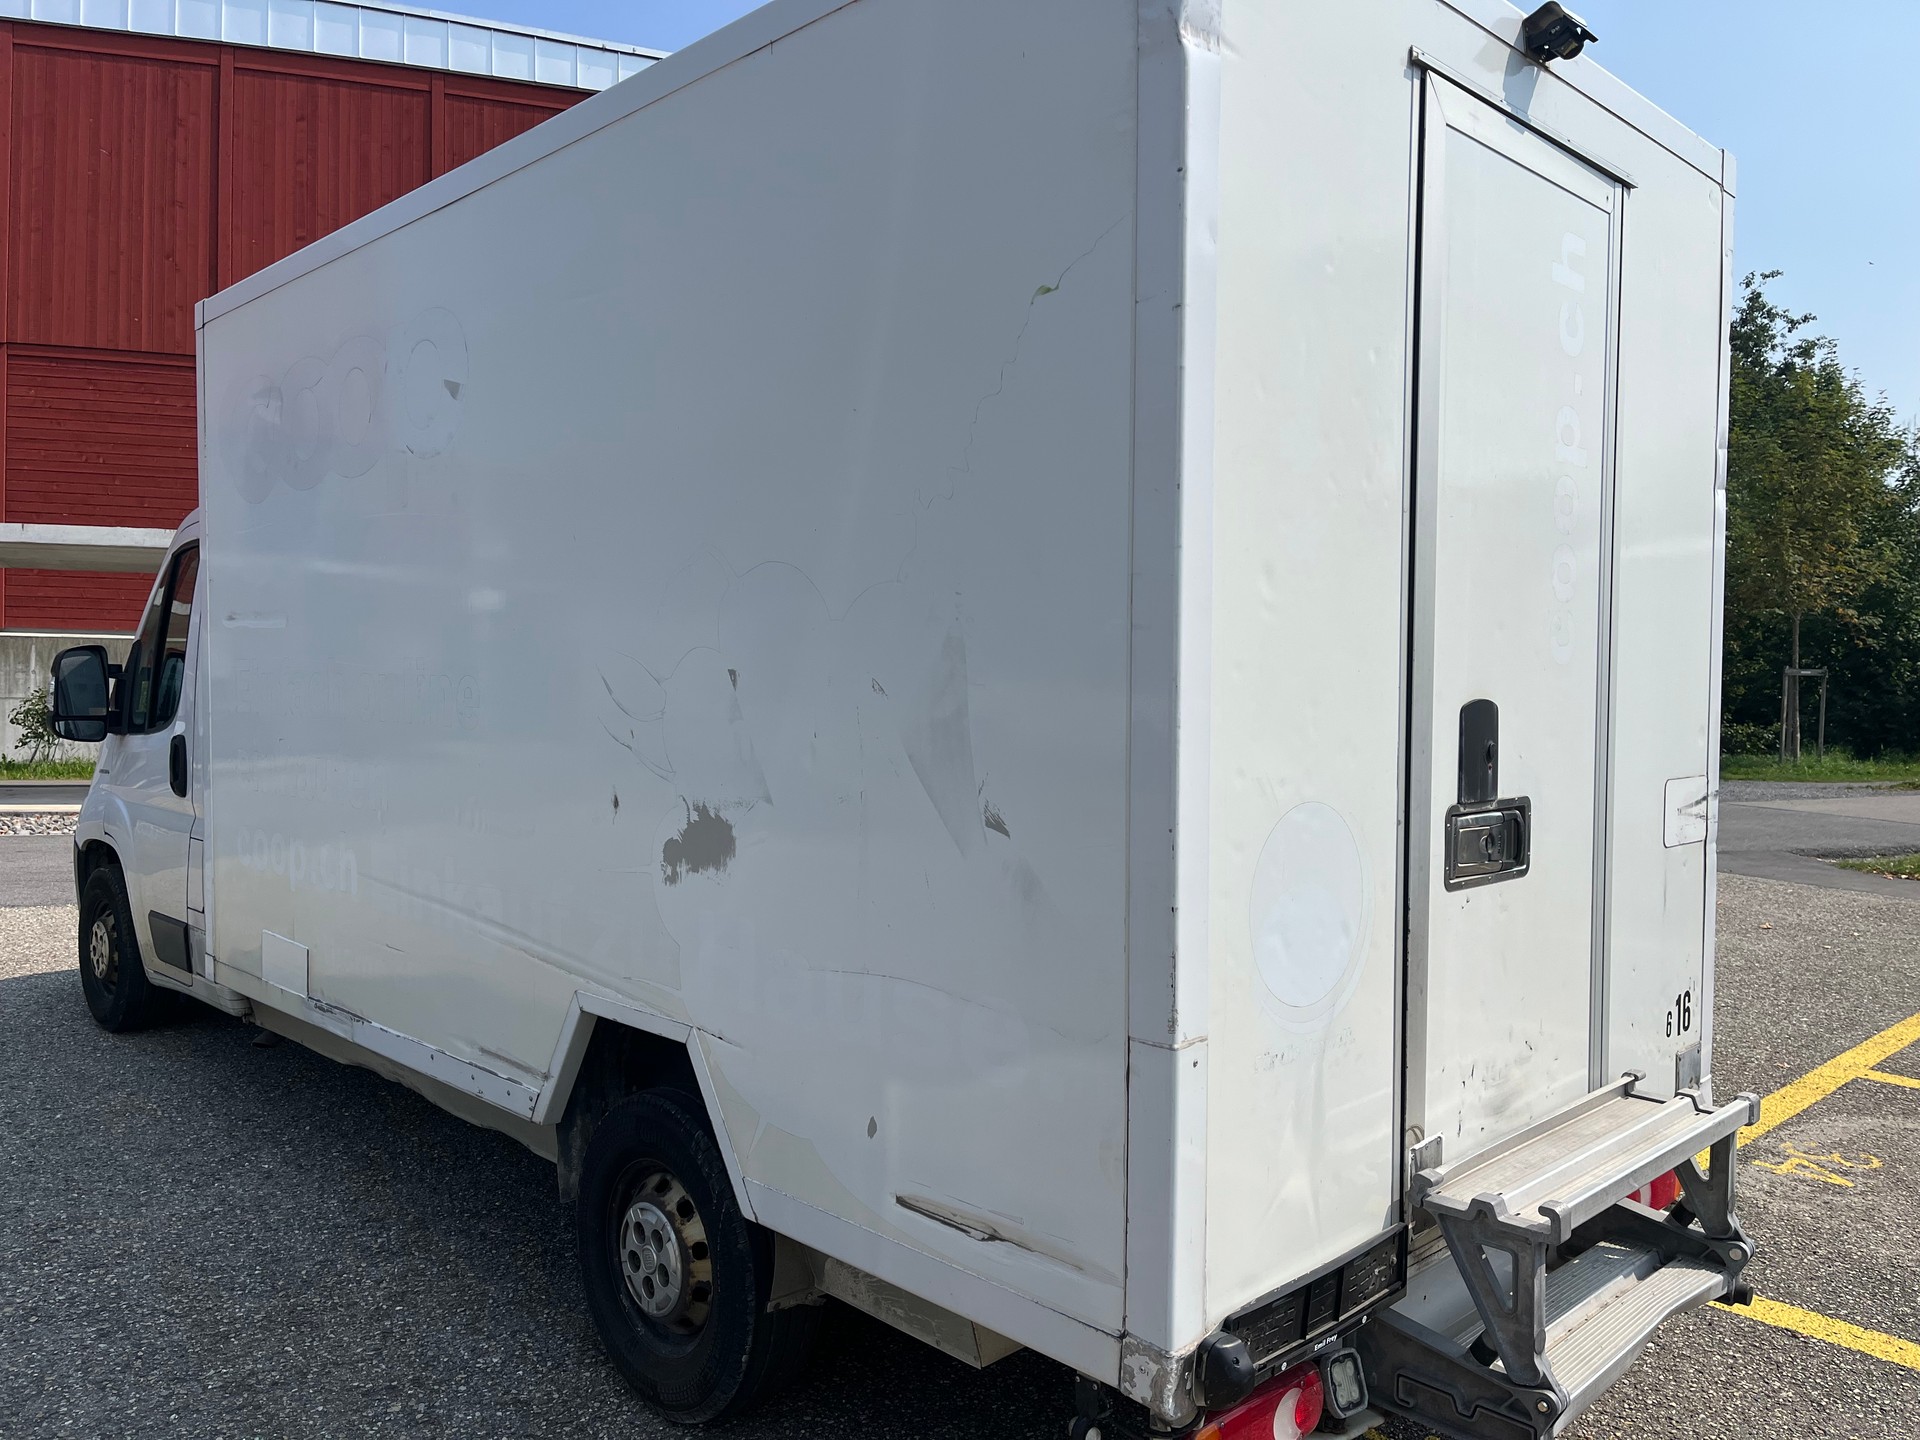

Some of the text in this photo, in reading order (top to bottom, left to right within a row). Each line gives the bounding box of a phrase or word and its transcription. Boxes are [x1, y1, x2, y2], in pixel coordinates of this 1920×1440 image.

[1666, 990, 1691, 1038] 6 16
[1314, 1338, 1326, 1351] Emil
